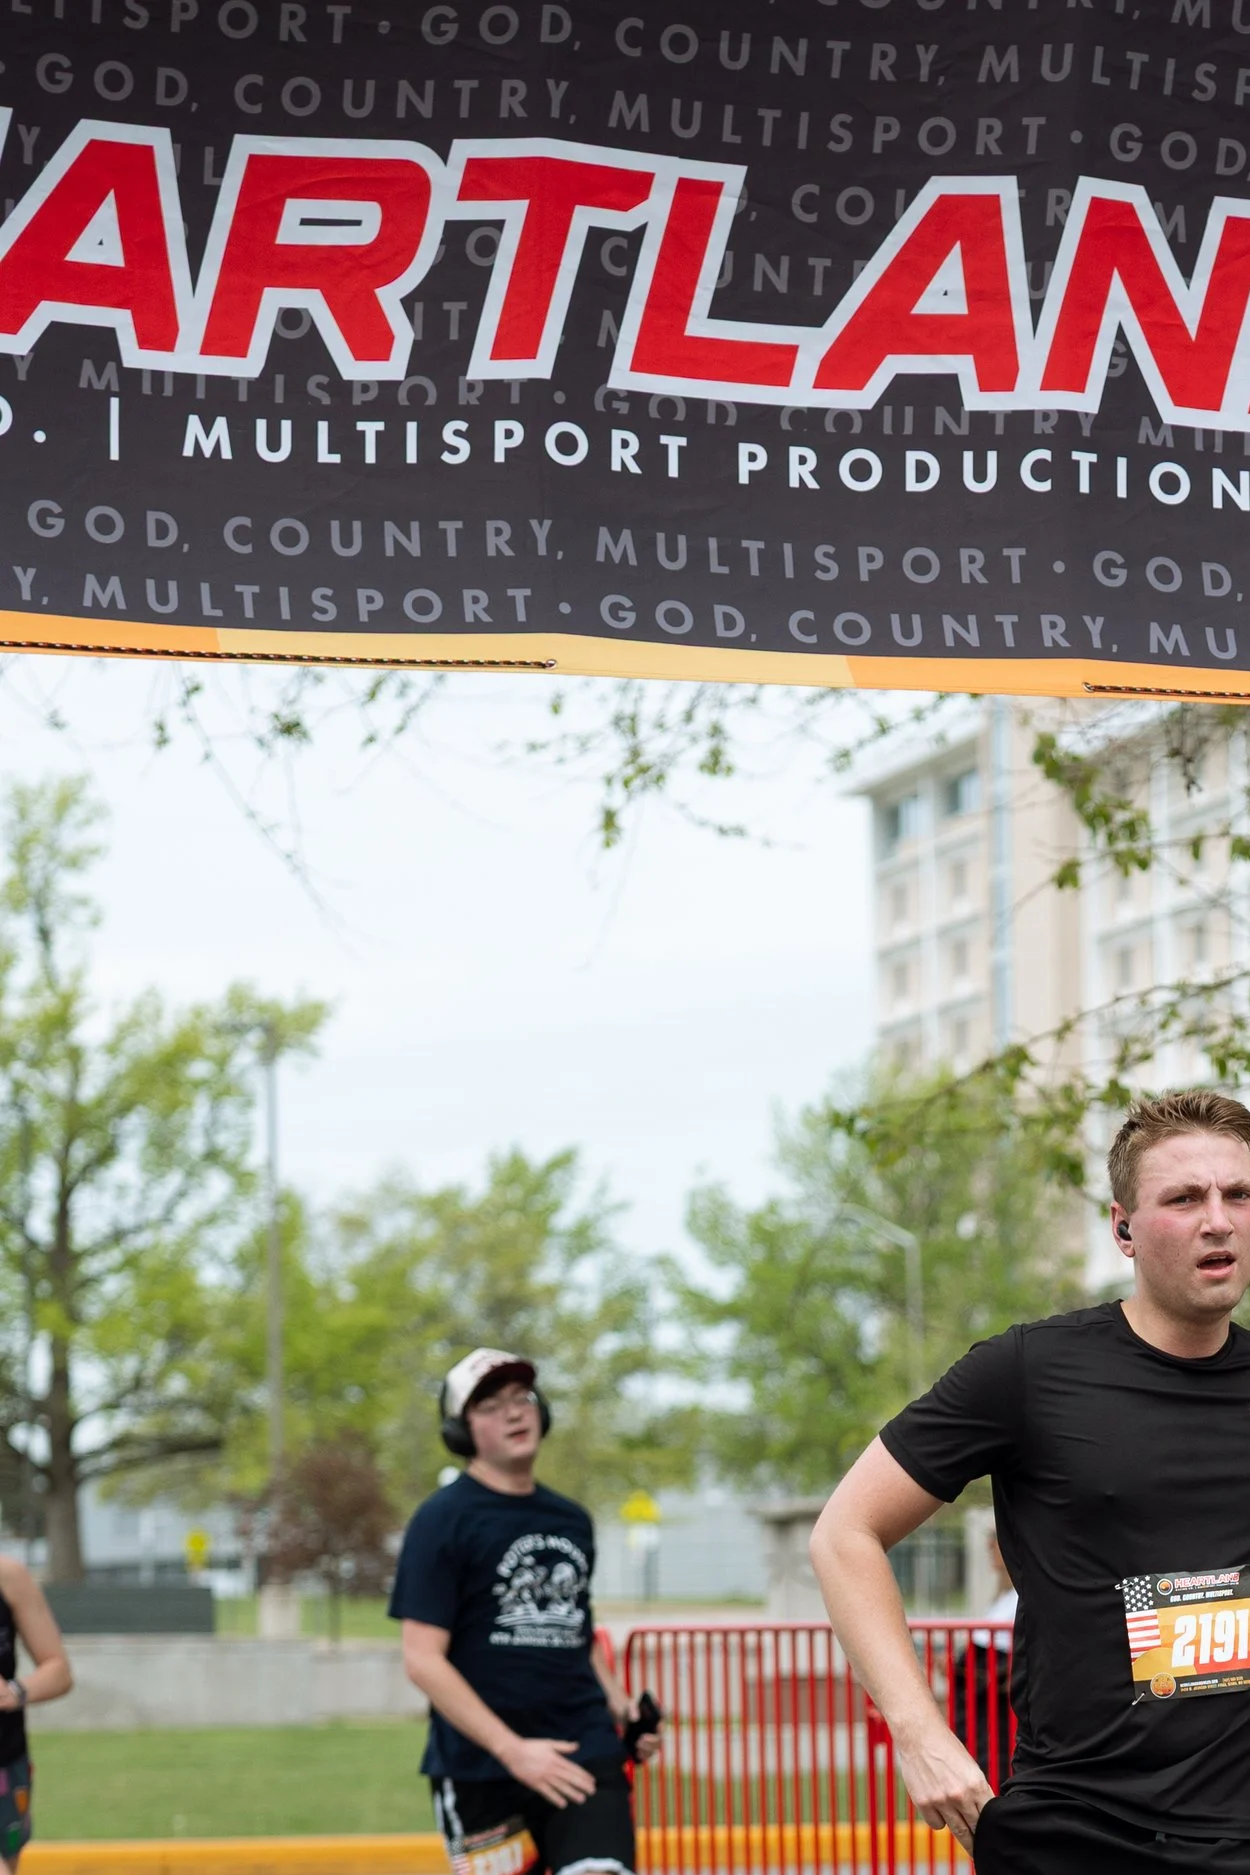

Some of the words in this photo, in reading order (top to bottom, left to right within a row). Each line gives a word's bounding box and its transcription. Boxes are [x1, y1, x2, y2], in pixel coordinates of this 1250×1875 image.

[421, 5, 581, 51] GOD,
[616, 18, 945, 86] COUNTRY,
[36, 53, 199, 113] GOD,
[235, 74, 577, 124] COUNTRY,
[609, 91, 1046, 155] MULTISPORT
[182, 414, 688, 478] MULTISPORT
[28, 500, 190, 552] GOD,
[223, 516, 563, 559] COUNTRY,
[596, 527, 1026, 583] MULTISPORT
[1093, 551, 1243, 601] GOD,
[83, 574, 531, 623] MULTISPORT
[600, 594, 757, 642] GOD,
[788, 610, 1118, 653] COUNTRY,
[1172, 1609, 1249, 1668] 2191
